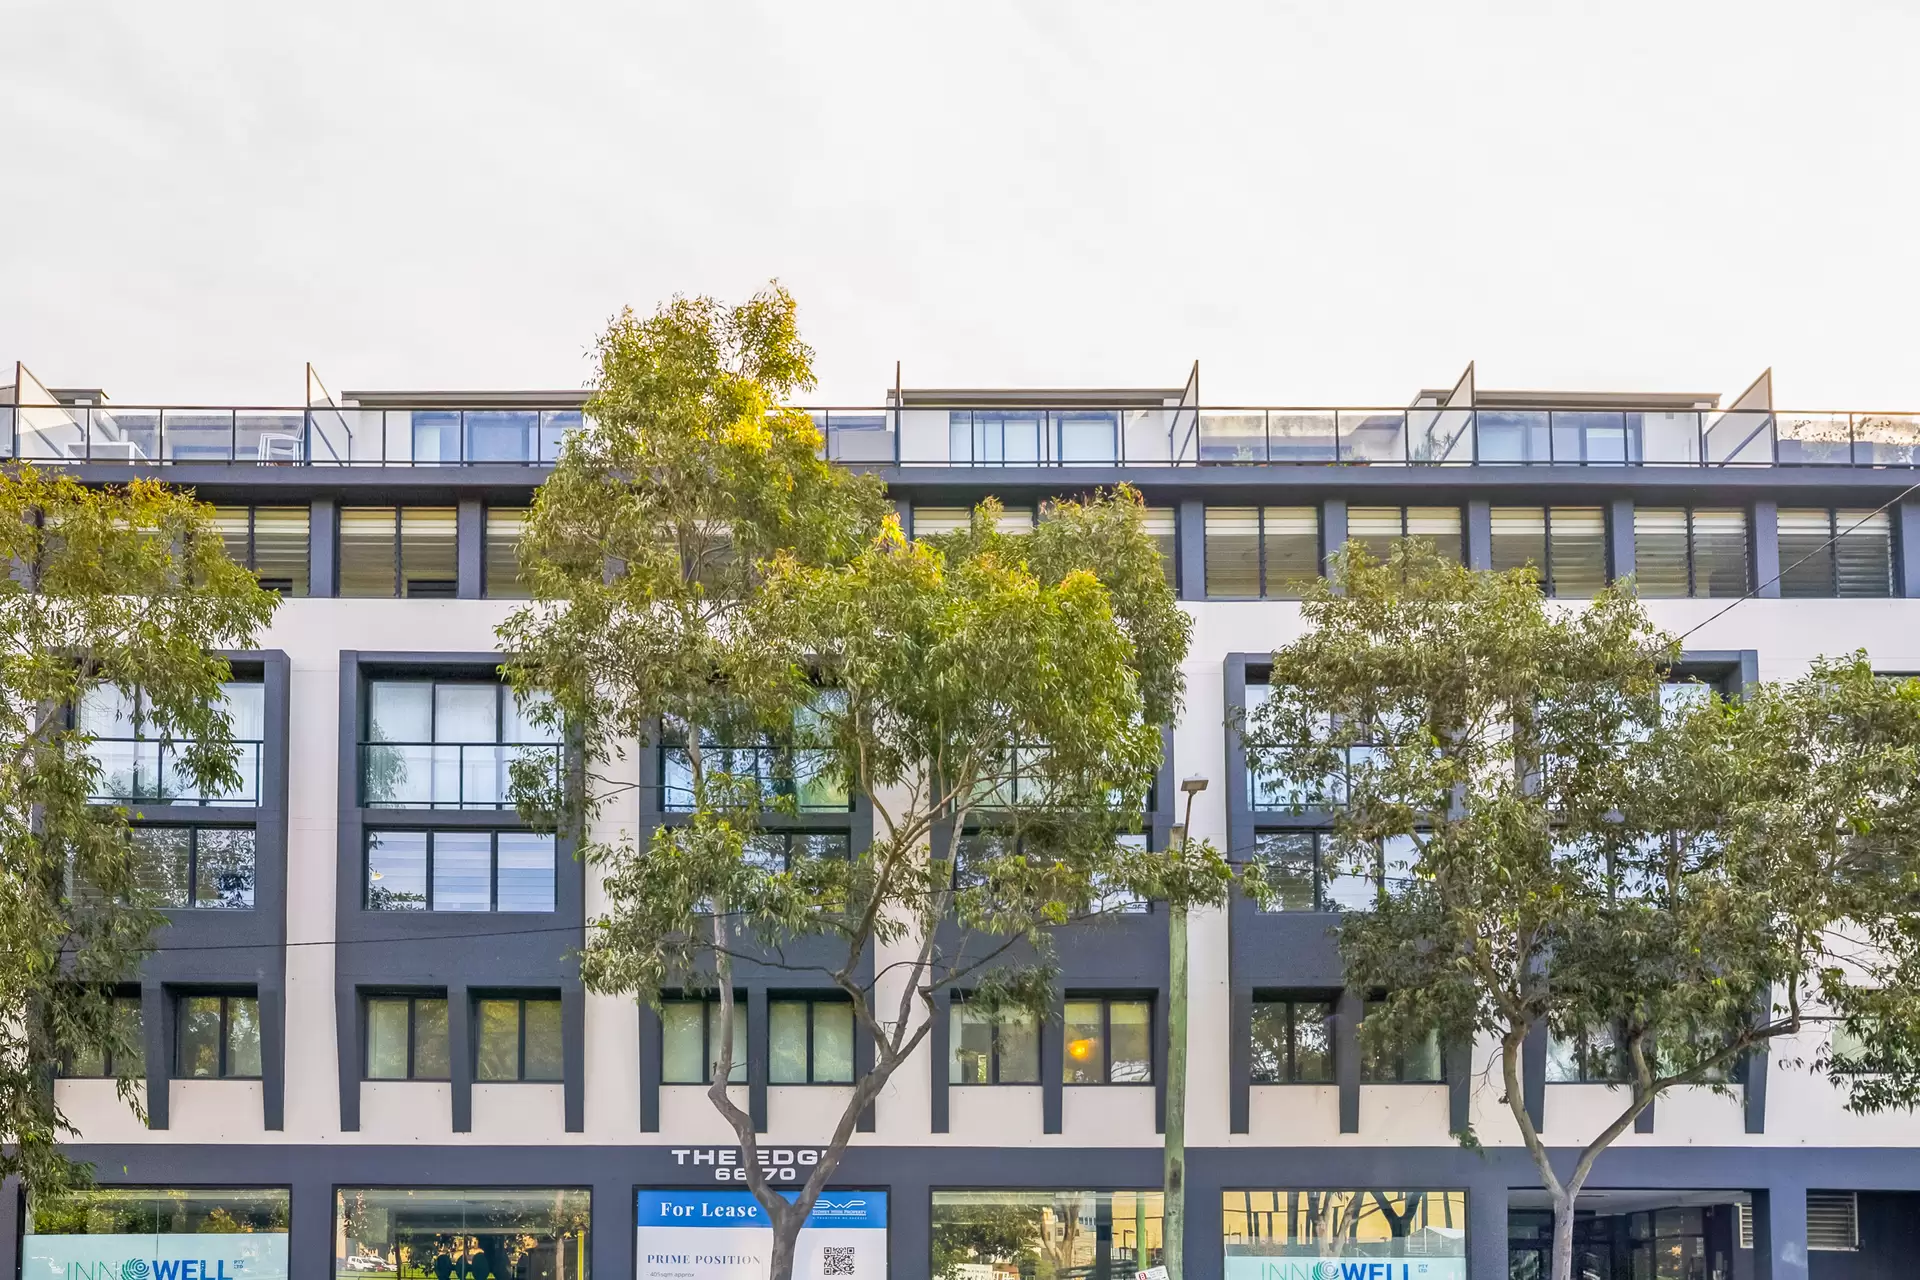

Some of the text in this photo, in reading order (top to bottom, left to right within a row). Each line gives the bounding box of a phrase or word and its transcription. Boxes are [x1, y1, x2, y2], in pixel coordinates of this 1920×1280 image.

[671, 1149, 840, 1165] THE EDG
[660, 1202, 757, 1218] For Lease
[647, 1254, 761, 1265] PRIME POSITION
